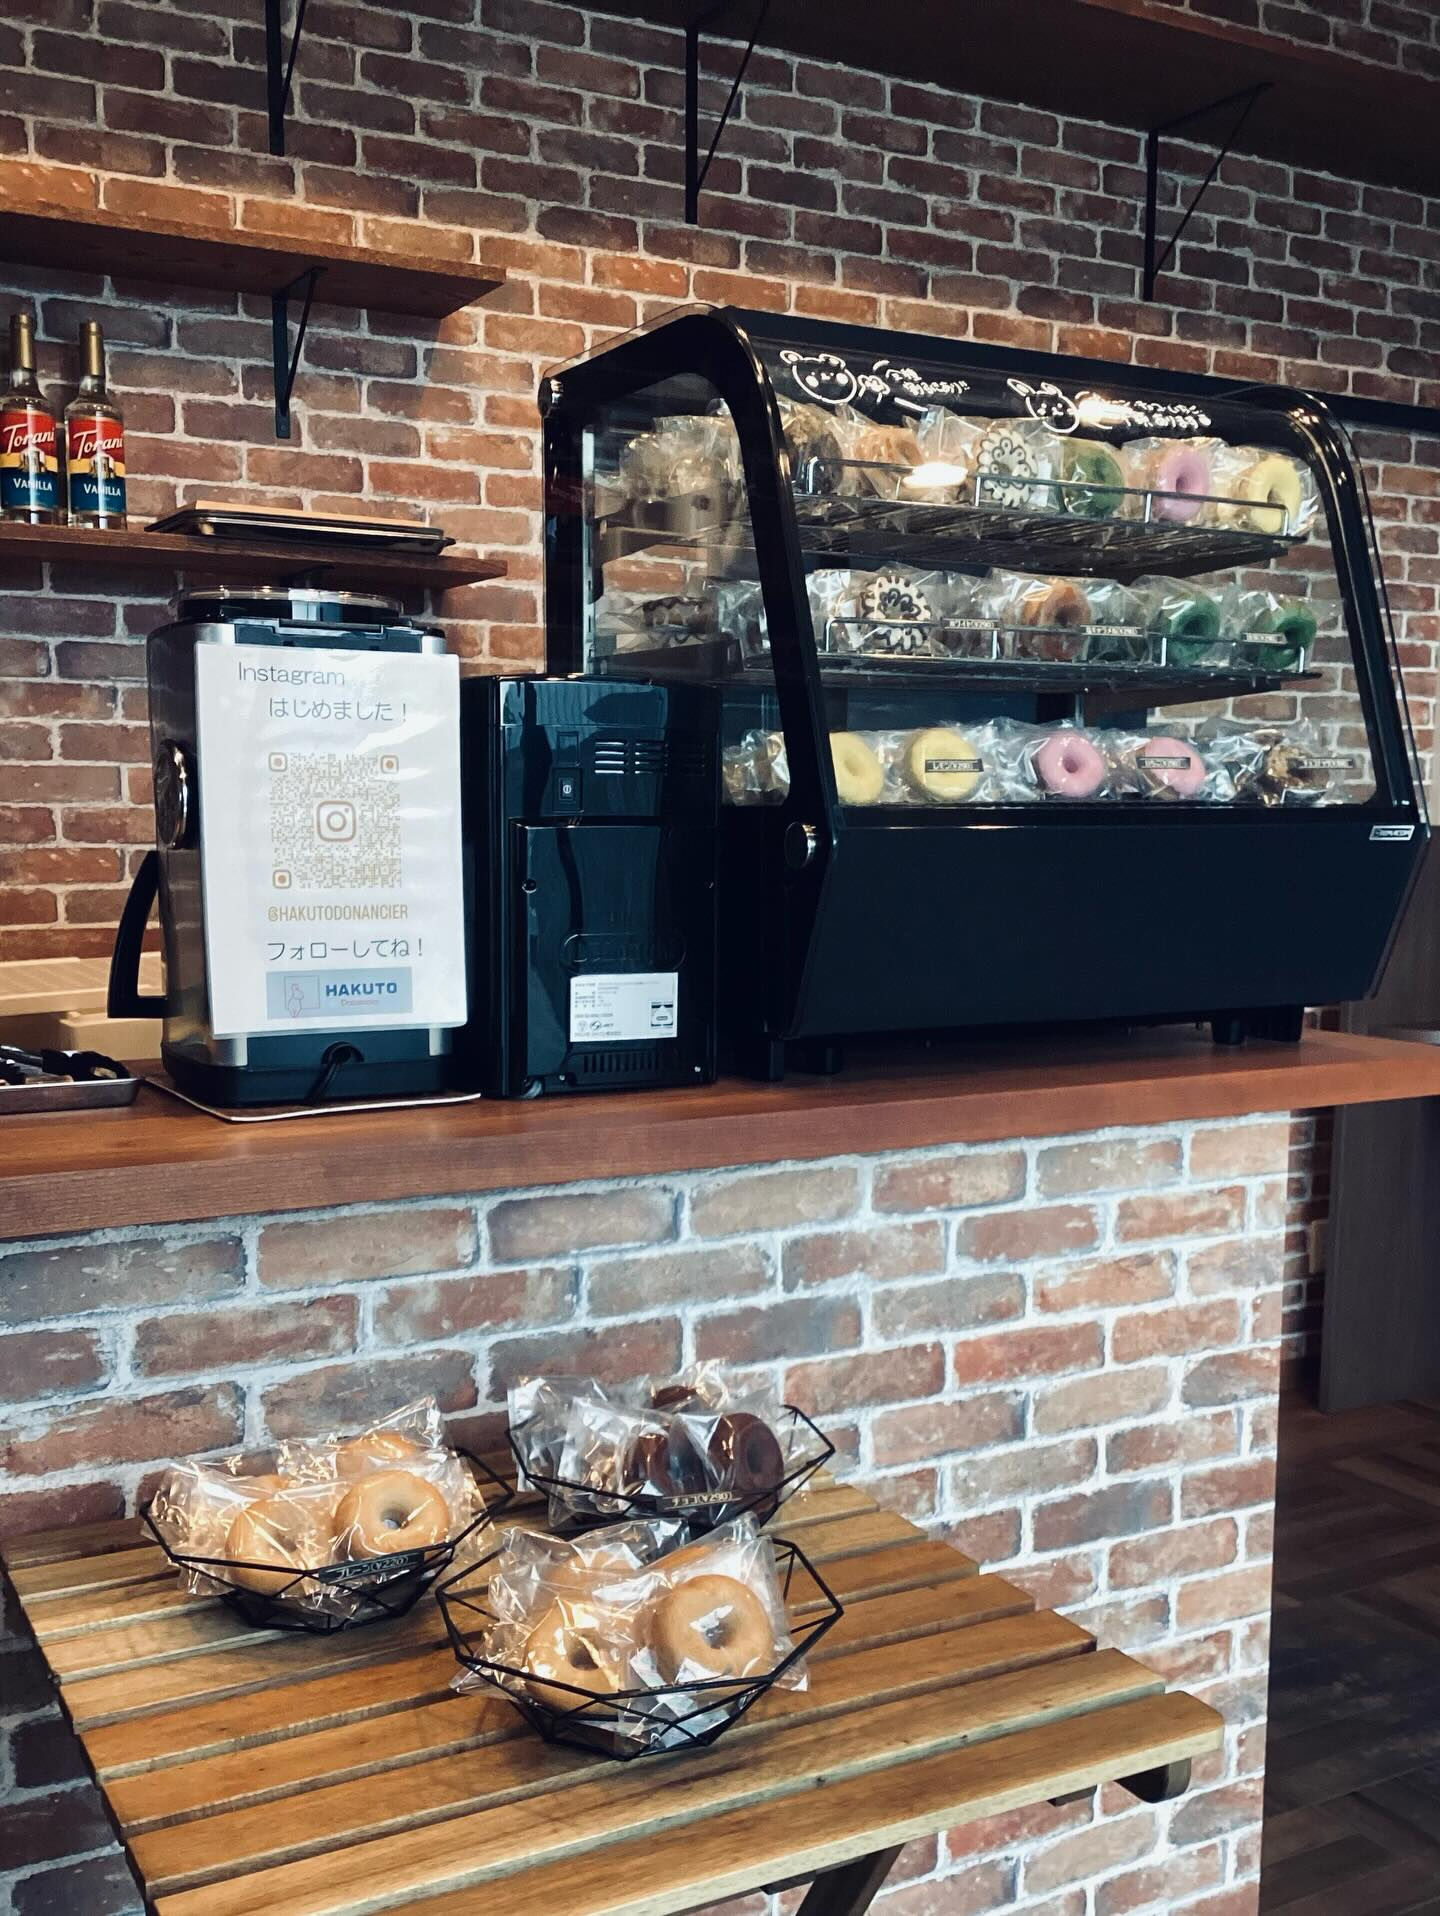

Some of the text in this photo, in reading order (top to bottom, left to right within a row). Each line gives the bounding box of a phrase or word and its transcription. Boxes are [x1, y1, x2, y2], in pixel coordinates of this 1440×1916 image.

[3, 421, 55, 455] Torani
[73, 429, 123, 460] Torani
[238, 661, 345, 685] Instagram
[267, 904, 409, 922] @HAKUTODONANCIER
[325, 982, 398, 997] HAKUTO
